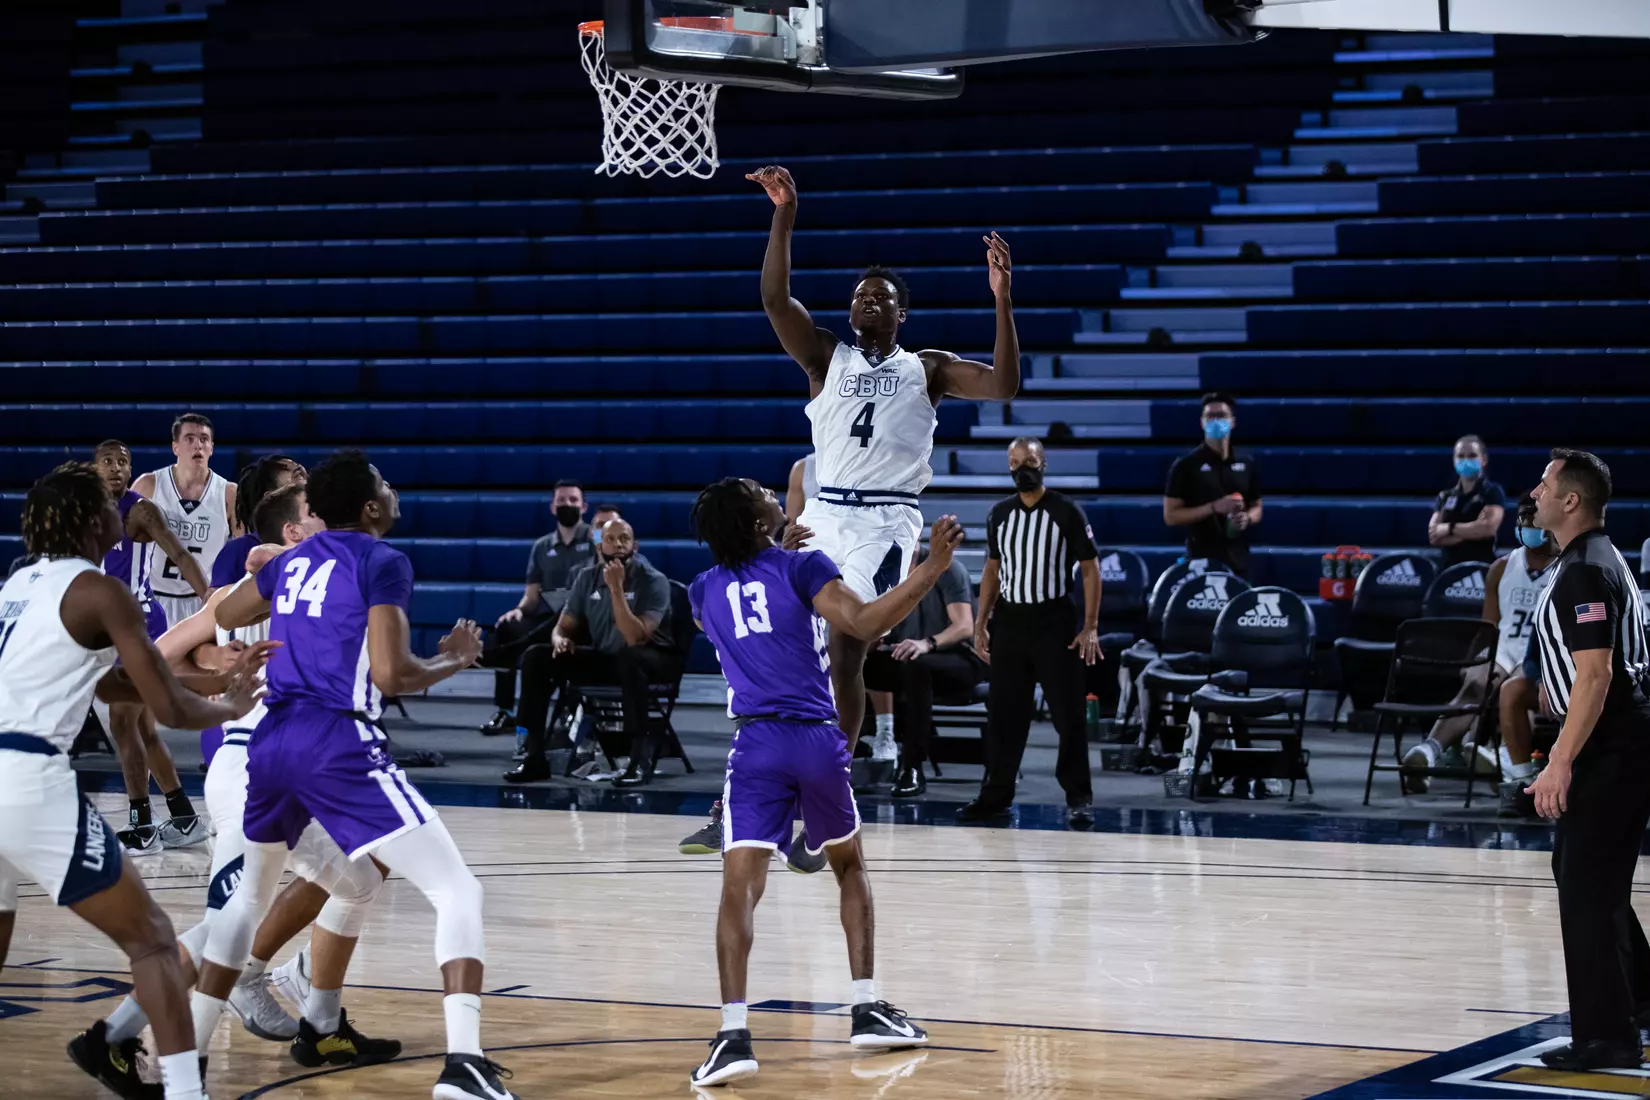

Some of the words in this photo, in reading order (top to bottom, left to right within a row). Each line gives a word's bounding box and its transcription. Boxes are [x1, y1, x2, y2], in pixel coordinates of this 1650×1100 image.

[839, 373, 900, 397] CBU
[849, 401, 876, 448] 4
[276, 556, 337, 618] 34
[726, 580, 774, 640] 13
[1237, 614, 1289, 628] adidas
